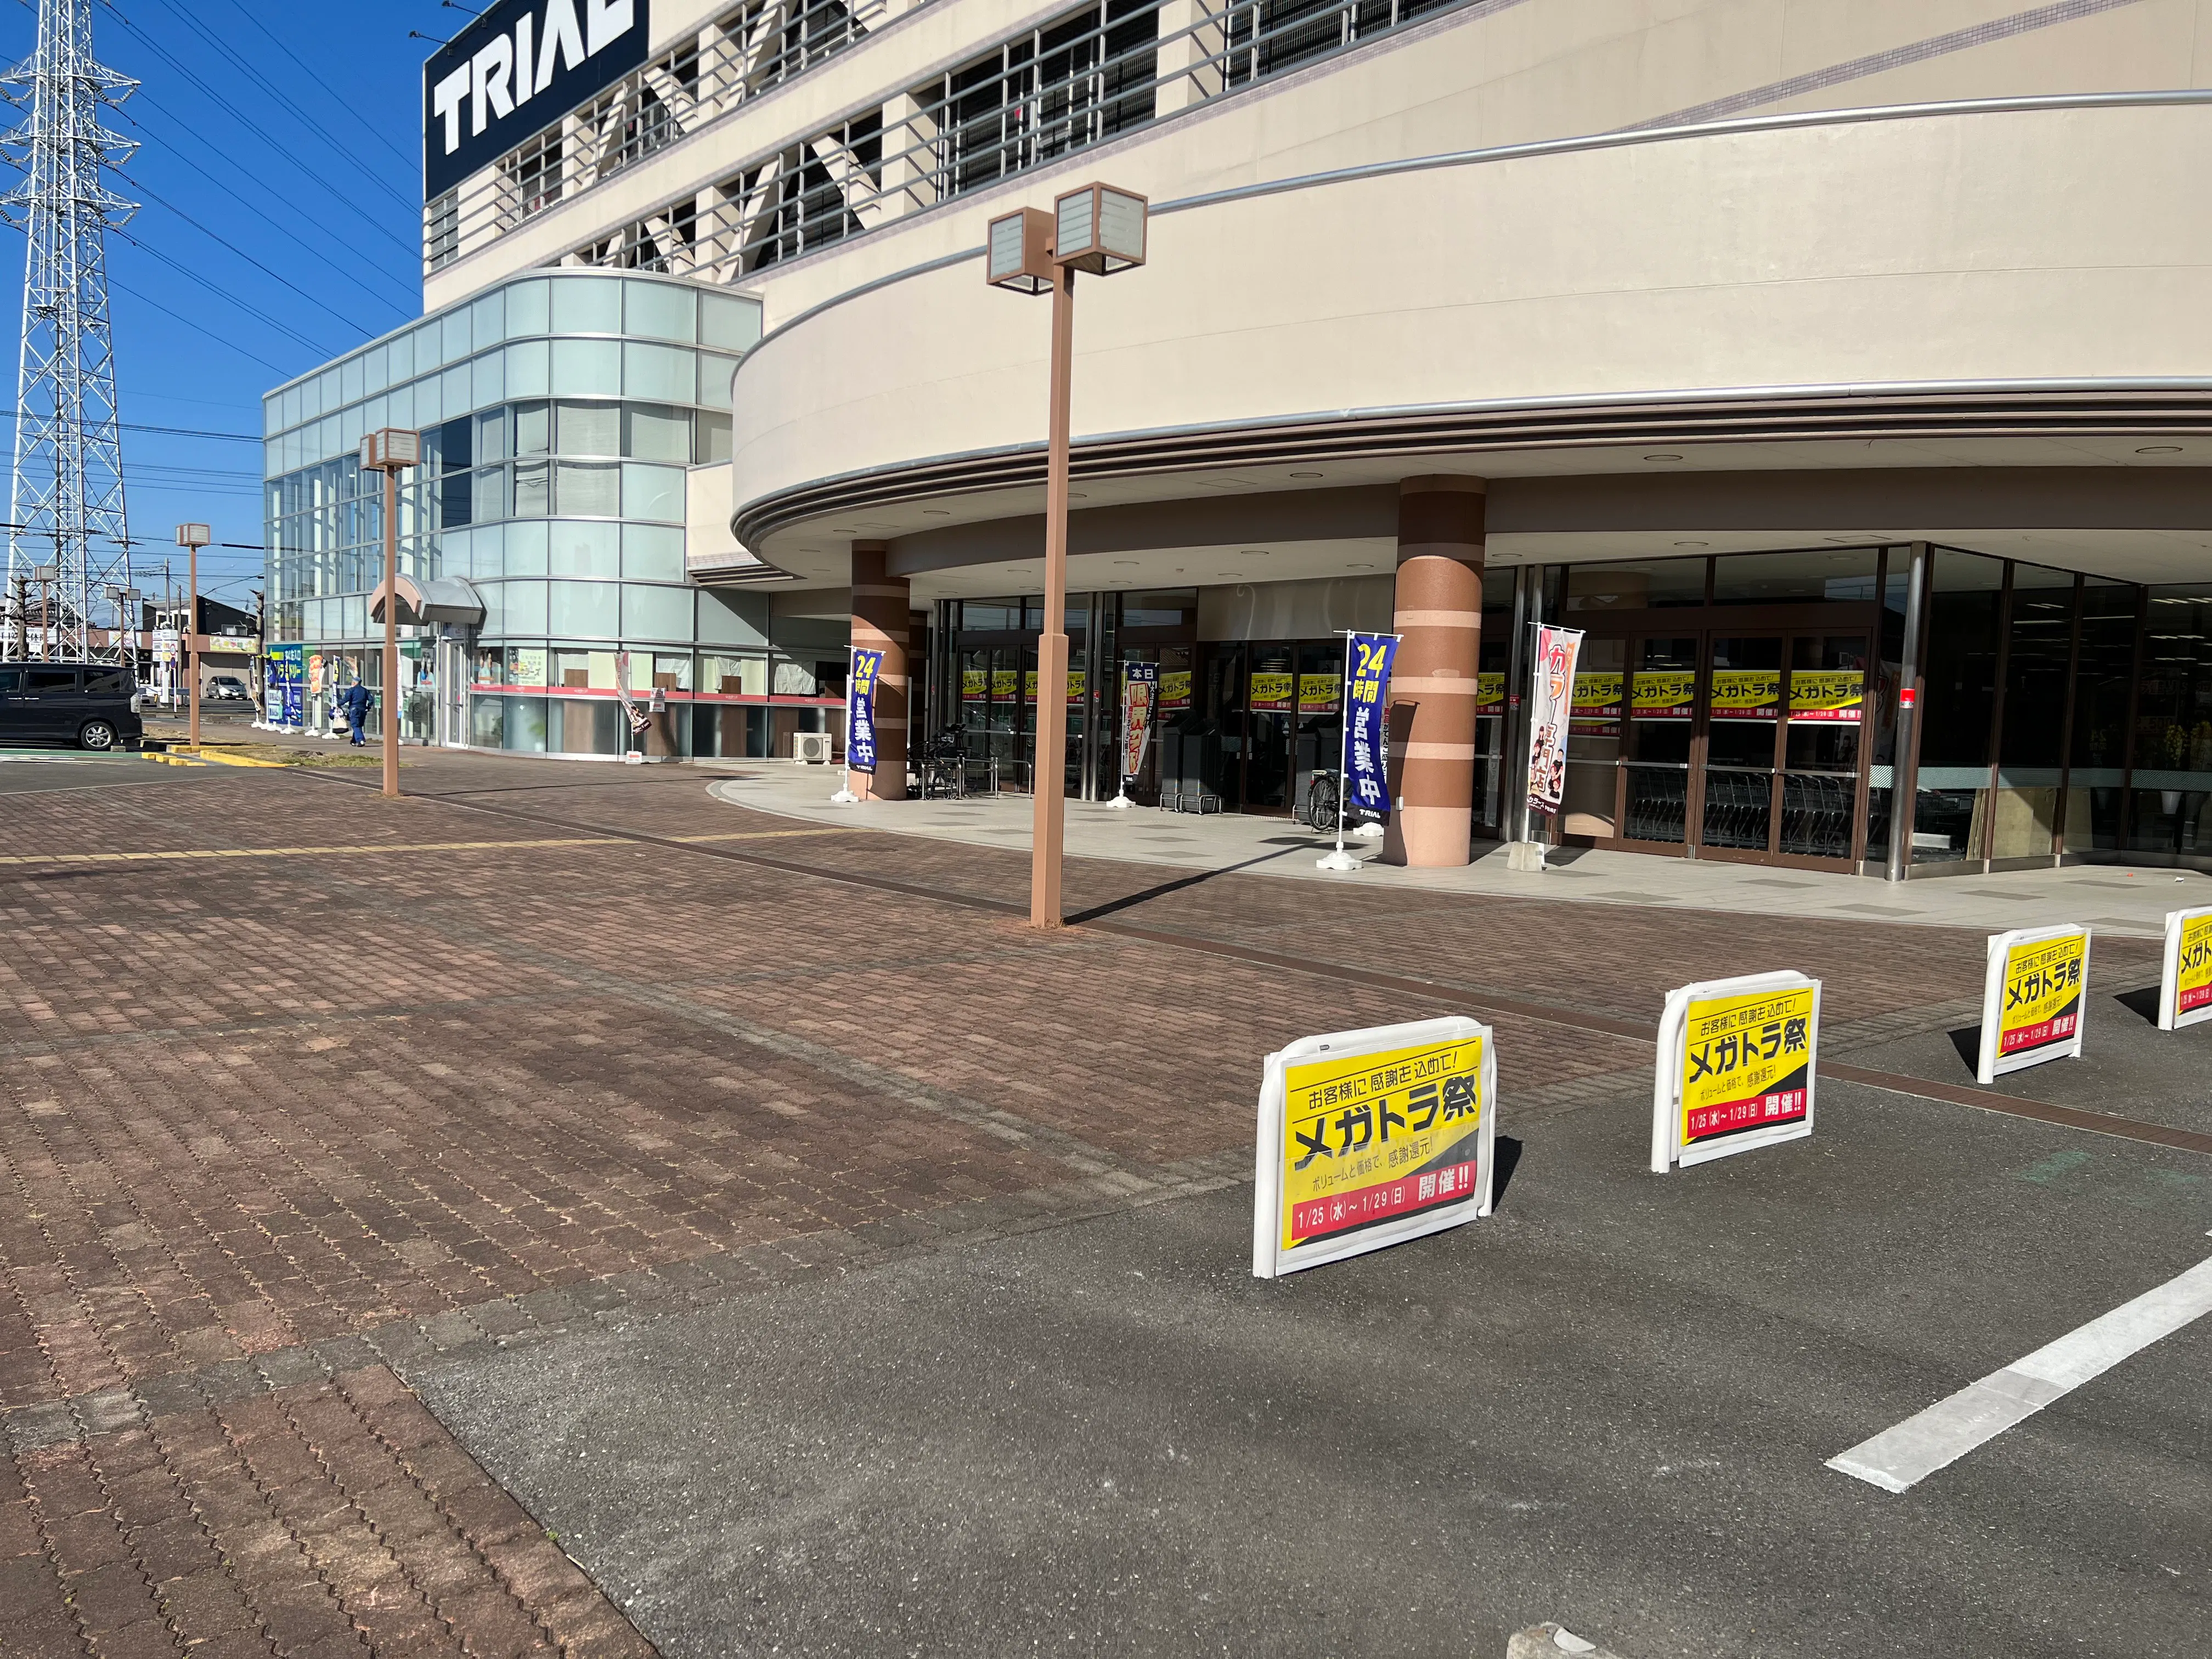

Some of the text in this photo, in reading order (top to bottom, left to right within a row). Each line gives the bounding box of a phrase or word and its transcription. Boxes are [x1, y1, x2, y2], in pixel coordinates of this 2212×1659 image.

[433, 0, 635, 156] TRIAL
[856, 655, 876, 678] 24
[1132, 668, 1153, 679] 本日
[1356, 644, 1387, 678] 24
[855, 679, 870, 695] 時間
[1252, 682, 1292, 694] メガトラ祭
[1300, 683, 1341, 697] メガトラ祭
[1353, 679, 1379, 703] 時間
[1632, 684, 1695, 699] メガトラ祭
[1711, 683, 1780, 698] メガトラ祭
[1790, 684, 1863, 700] メガトラ祭
[854, 697, 874, 762] 営業中
[1354, 706, 1381, 805] 営業中
[1359, 809, 1381, 819] TRIAL
[2007, 958, 2081, 1011] メガトラ祭
[1701, 998, 1796, 1036] お客様に感謝を込めて!
[1689, 1018, 1807, 1084] メガトラ祭
[1309, 1051, 1458, 1110] お客様に感謝を込めて!
[1765, 1091, 1802, 1117] 開催!!
[1295, 1074, 1477, 1171] メガトラ祭
[1418, 1165, 1470, 1201] 開催!!
